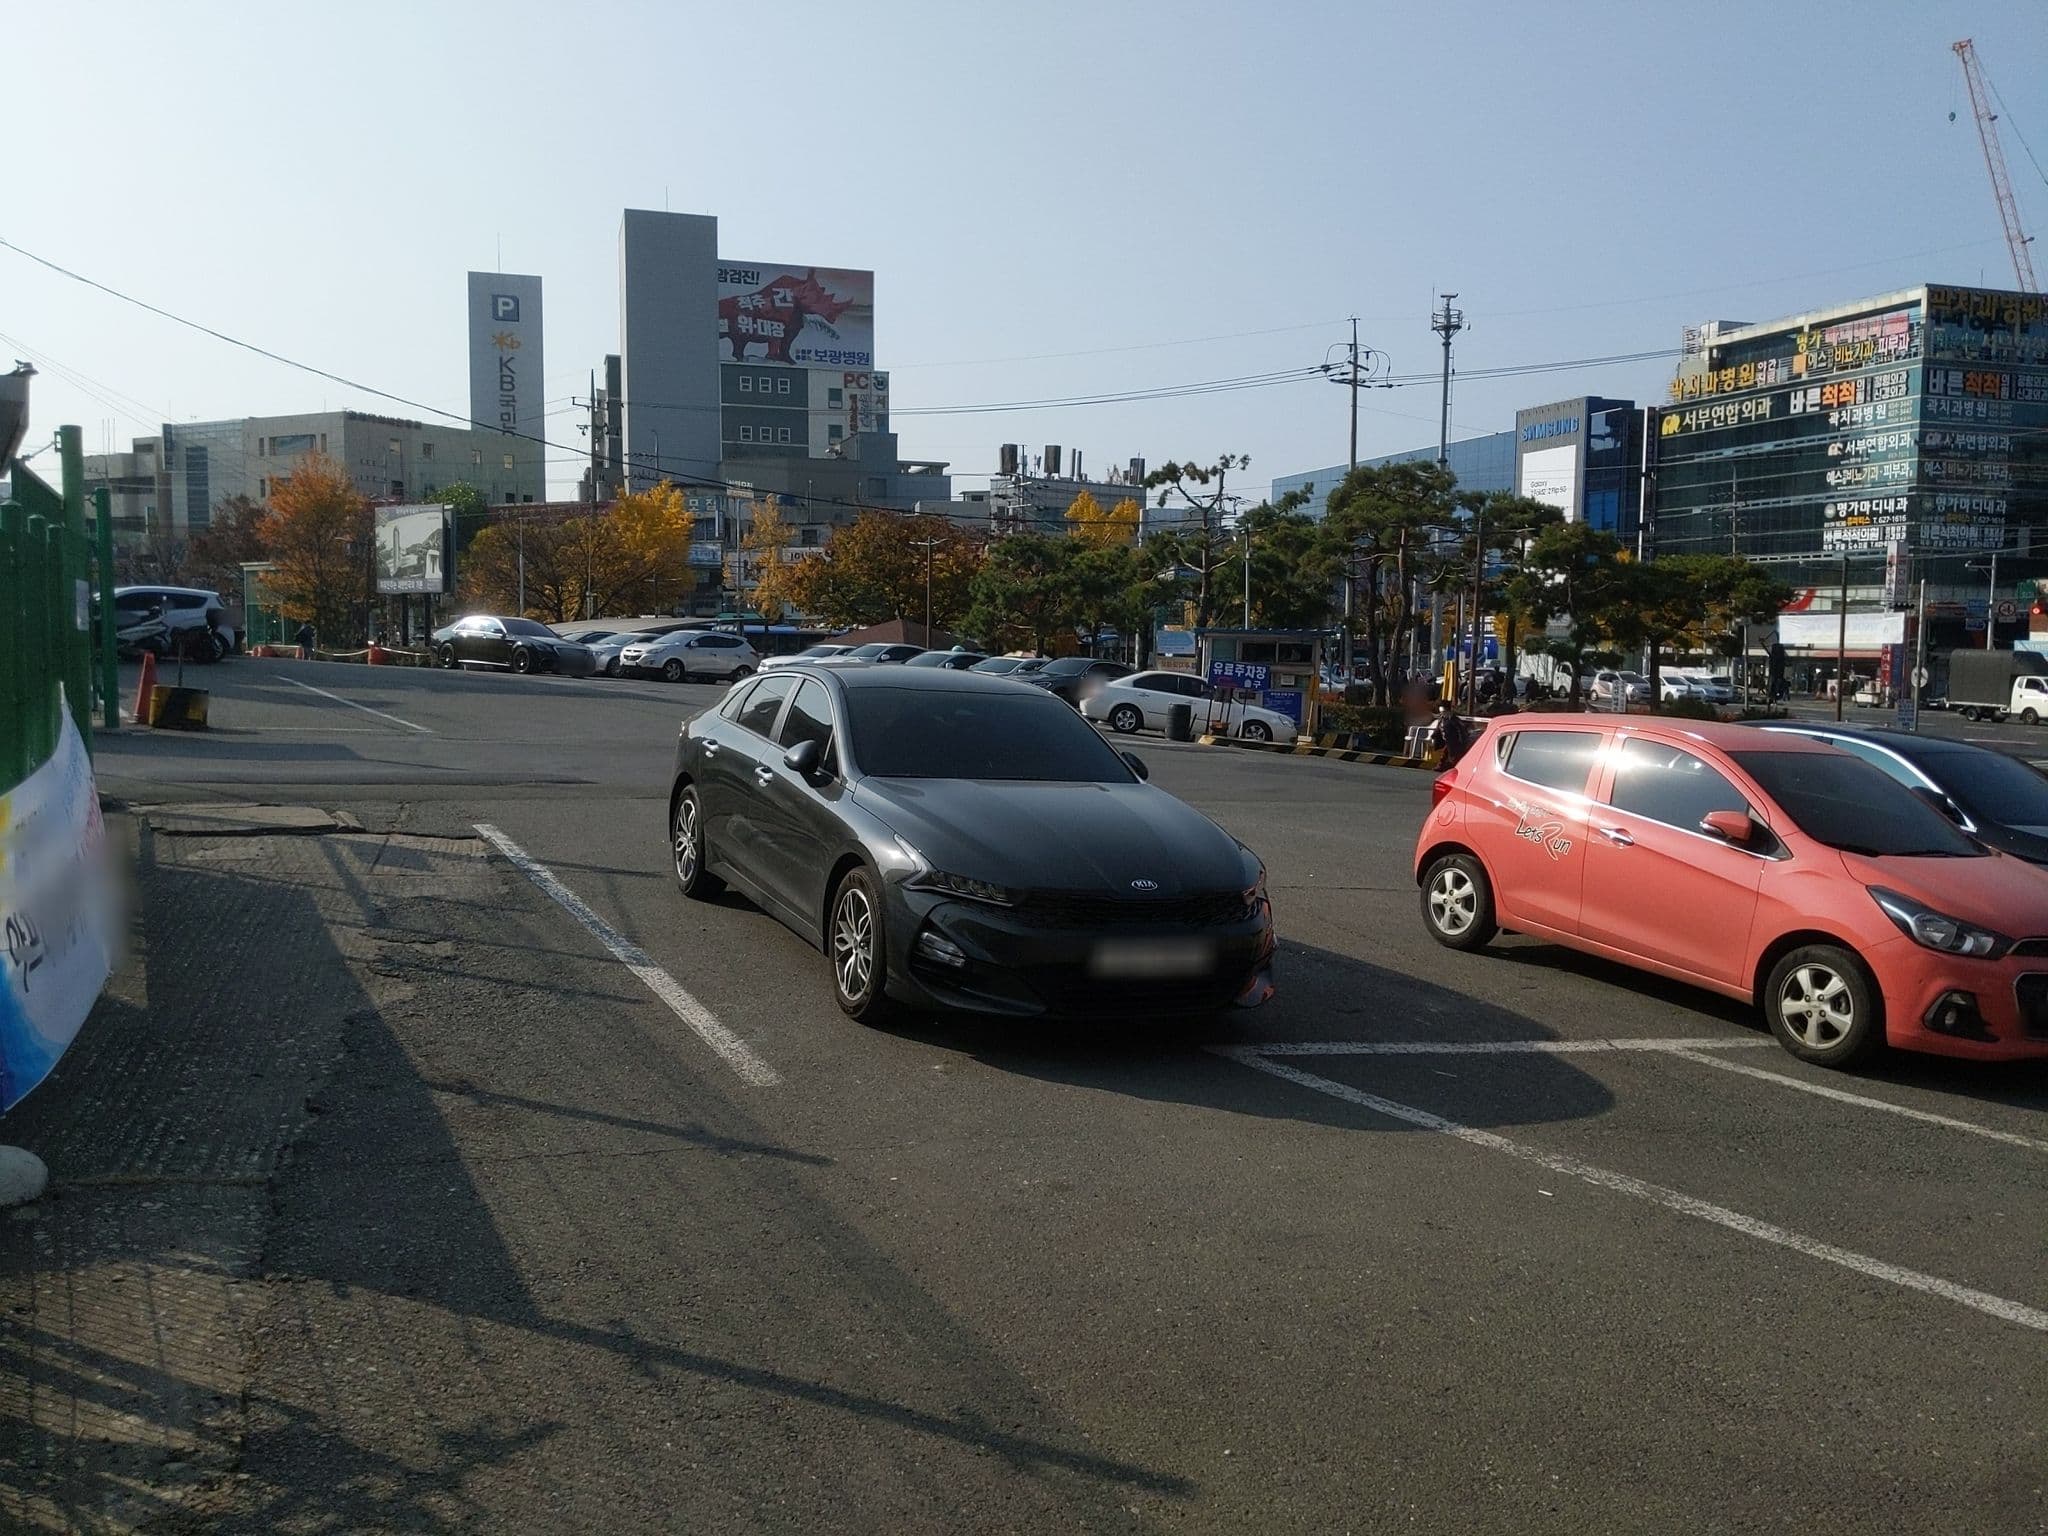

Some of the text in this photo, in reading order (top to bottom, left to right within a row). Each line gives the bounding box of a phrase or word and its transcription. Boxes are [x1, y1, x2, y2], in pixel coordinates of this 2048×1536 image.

[498, 297, 514, 317] P
[815, 350, 870, 366] 보광병원
[844, 373, 868, 389] PC
[1683, 396, 1772, 431] 서부연합외과
[1828, 403, 1887, 427] 곽치과병원
[1926, 398, 1988, 418] 곽치과병원
[1521, 416, 1580, 442] SAMSUNG
[1844, 432, 1911, 456] 서부연합외과
[1836, 497, 1908, 518] 명가마디내과
[1213, 662, 1267, 680] 유료주차장
